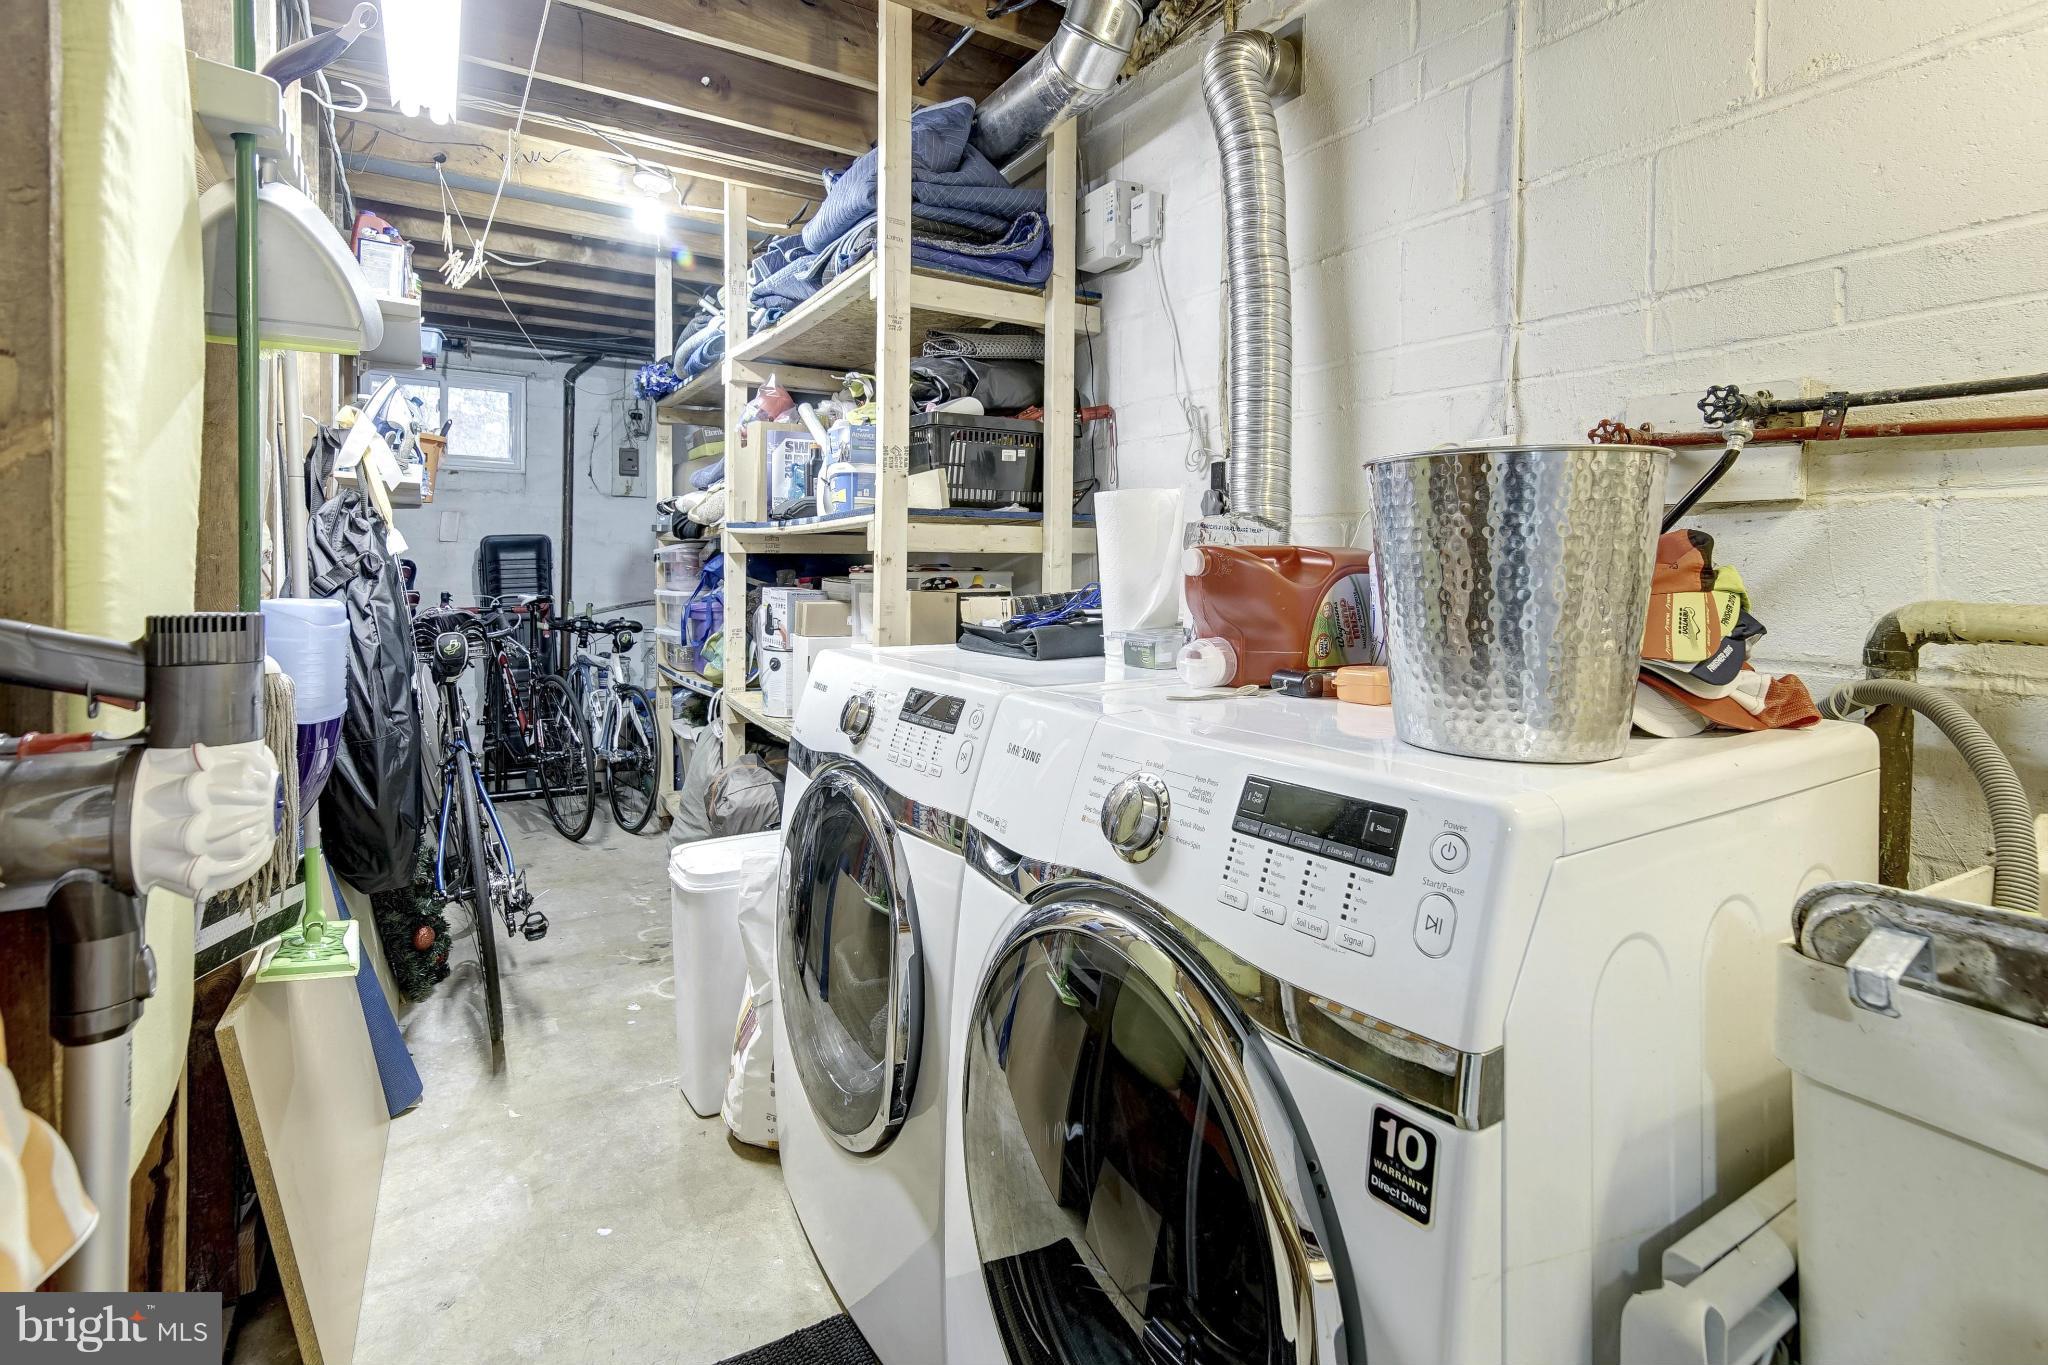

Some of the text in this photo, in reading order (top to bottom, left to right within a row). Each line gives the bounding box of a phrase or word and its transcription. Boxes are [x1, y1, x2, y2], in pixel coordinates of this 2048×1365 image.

[1721, 604, 1733, 627] FINISHER
[1334, 601, 1349, 648] Wegmans
[1706, 652, 1727, 673] FINISHER
[1180, 819, 1206, 832] Quick Wash
[1376, 824, 1392, 834] Steam
[1443, 819, 1468, 832] Power
[1331, 846, 1353, 859] Extra Spin
[1366, 857, 1388, 869] My Cycle
[1422, 877, 1465, 896] Start/Pause
[1261, 905, 1274, 916] Spin
[1296, 917, 1323, 933] Soil Level
[1343, 933, 1364, 947] Signal
[1380, 1118, 1428, 1171] 10
[1374, 1158, 1429, 1195] WARRANTY
[1371, 1174, 1400, 1199] Direct
[1401, 1191, 1428, 1215] Drive
